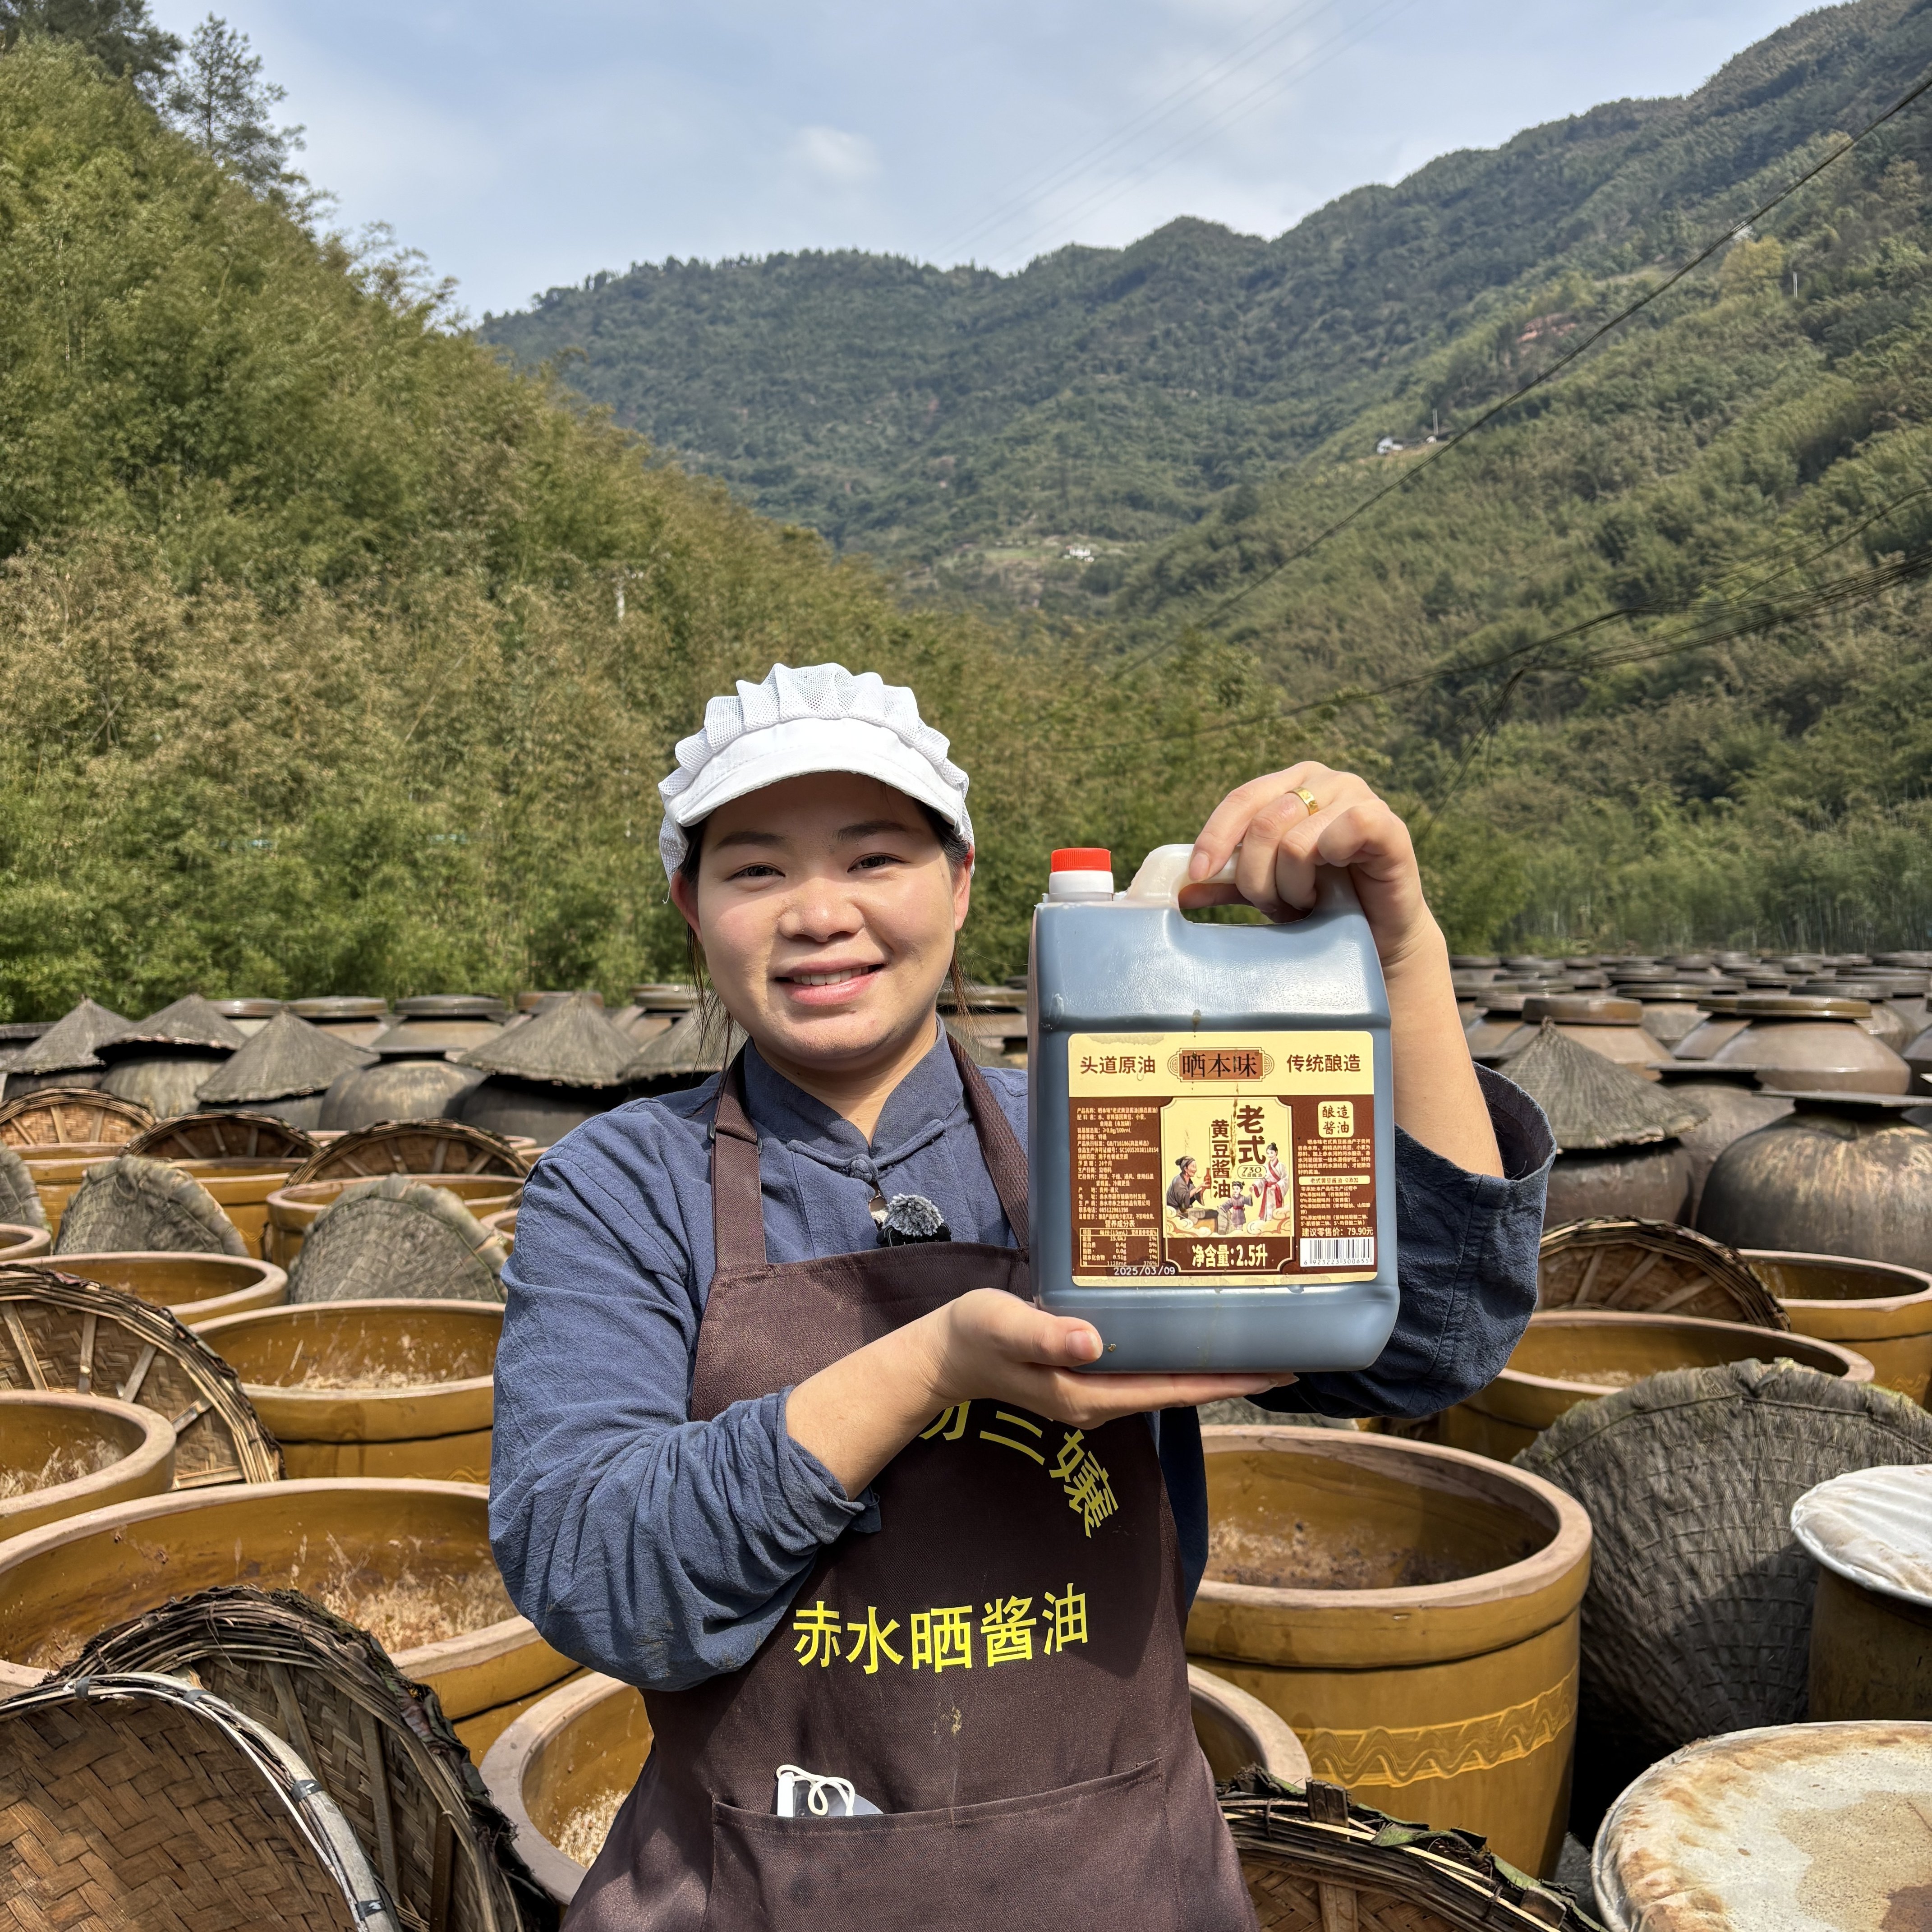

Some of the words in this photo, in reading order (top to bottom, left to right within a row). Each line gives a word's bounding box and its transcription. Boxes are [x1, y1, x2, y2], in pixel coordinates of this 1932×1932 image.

[1080, 1056, 1155, 1074] 头道原油
[1182, 1053, 1257, 1077] 晒本味
[1287, 1054, 1361, 1072] 传统酿造
[1322, 1105, 1350, 1119] 酿造
[1237, 1105, 1266, 1164] 老式
[1323, 1121, 1349, 1135] 酱油
[1211, 1119, 1231, 1199] 黄豆酱油
[1192, 1243, 1268, 1267] 净含量:2.5升
[1113, 1265, 1175, 1275] 2025/03/09
[793, 1583, 1088, 1674] 赤水晒酱油
